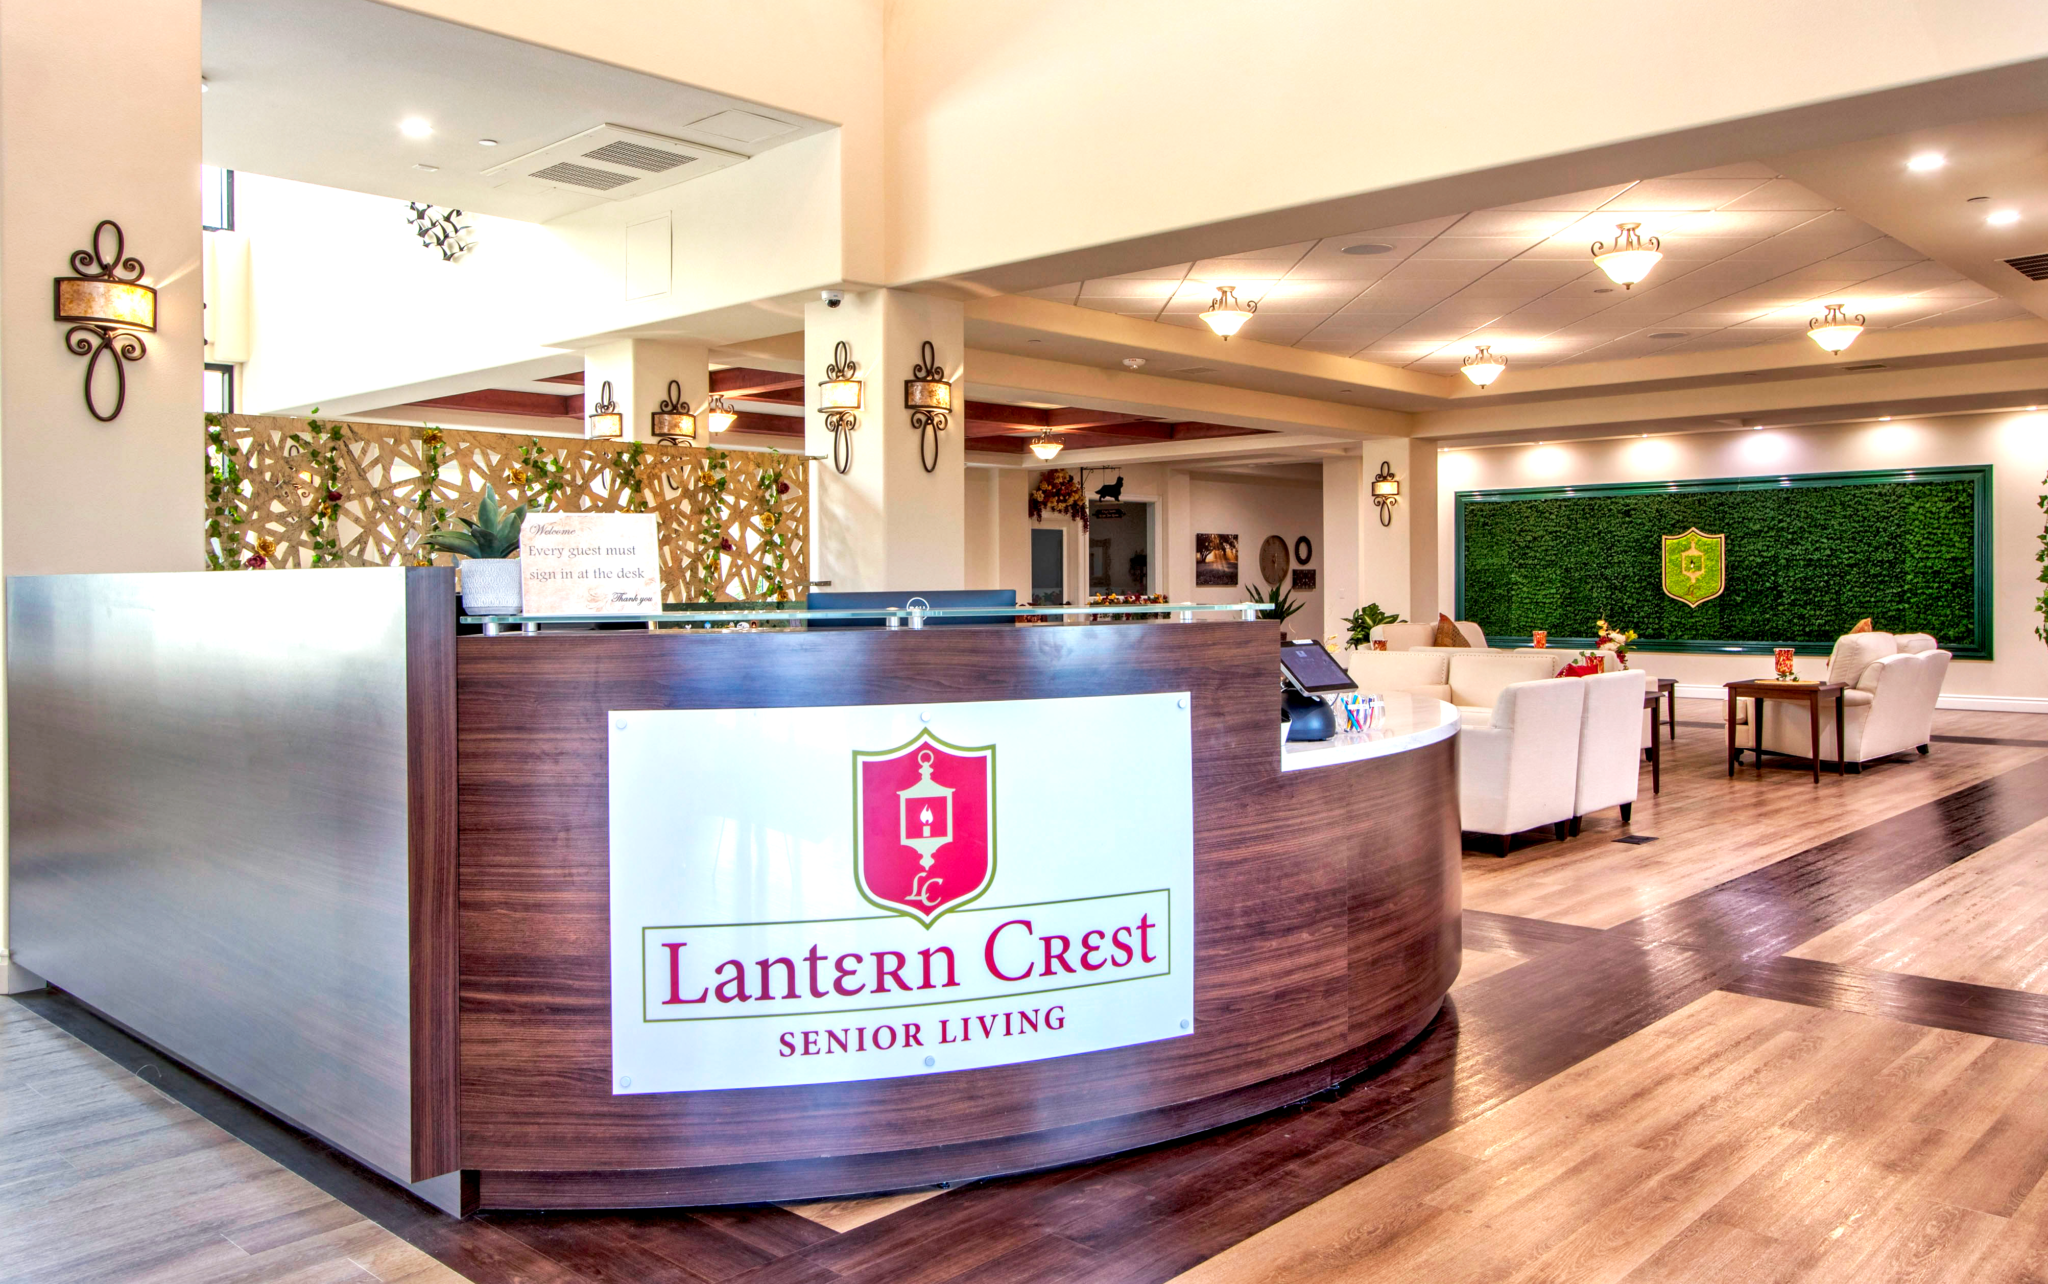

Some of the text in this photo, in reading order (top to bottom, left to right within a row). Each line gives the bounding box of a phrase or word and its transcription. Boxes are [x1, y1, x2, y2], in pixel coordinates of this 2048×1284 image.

[529, 523, 576, 536] Welcome
[528, 545, 636, 558] Every guest must
[529, 567, 645, 582] sign in at the desk
[611, 591, 653, 606] Thank you
[904, 872, 943, 907] LC
[661, 912, 1157, 1006] Lantern Crest
[779, 1004, 1067, 1058] SENIOR LIVING
